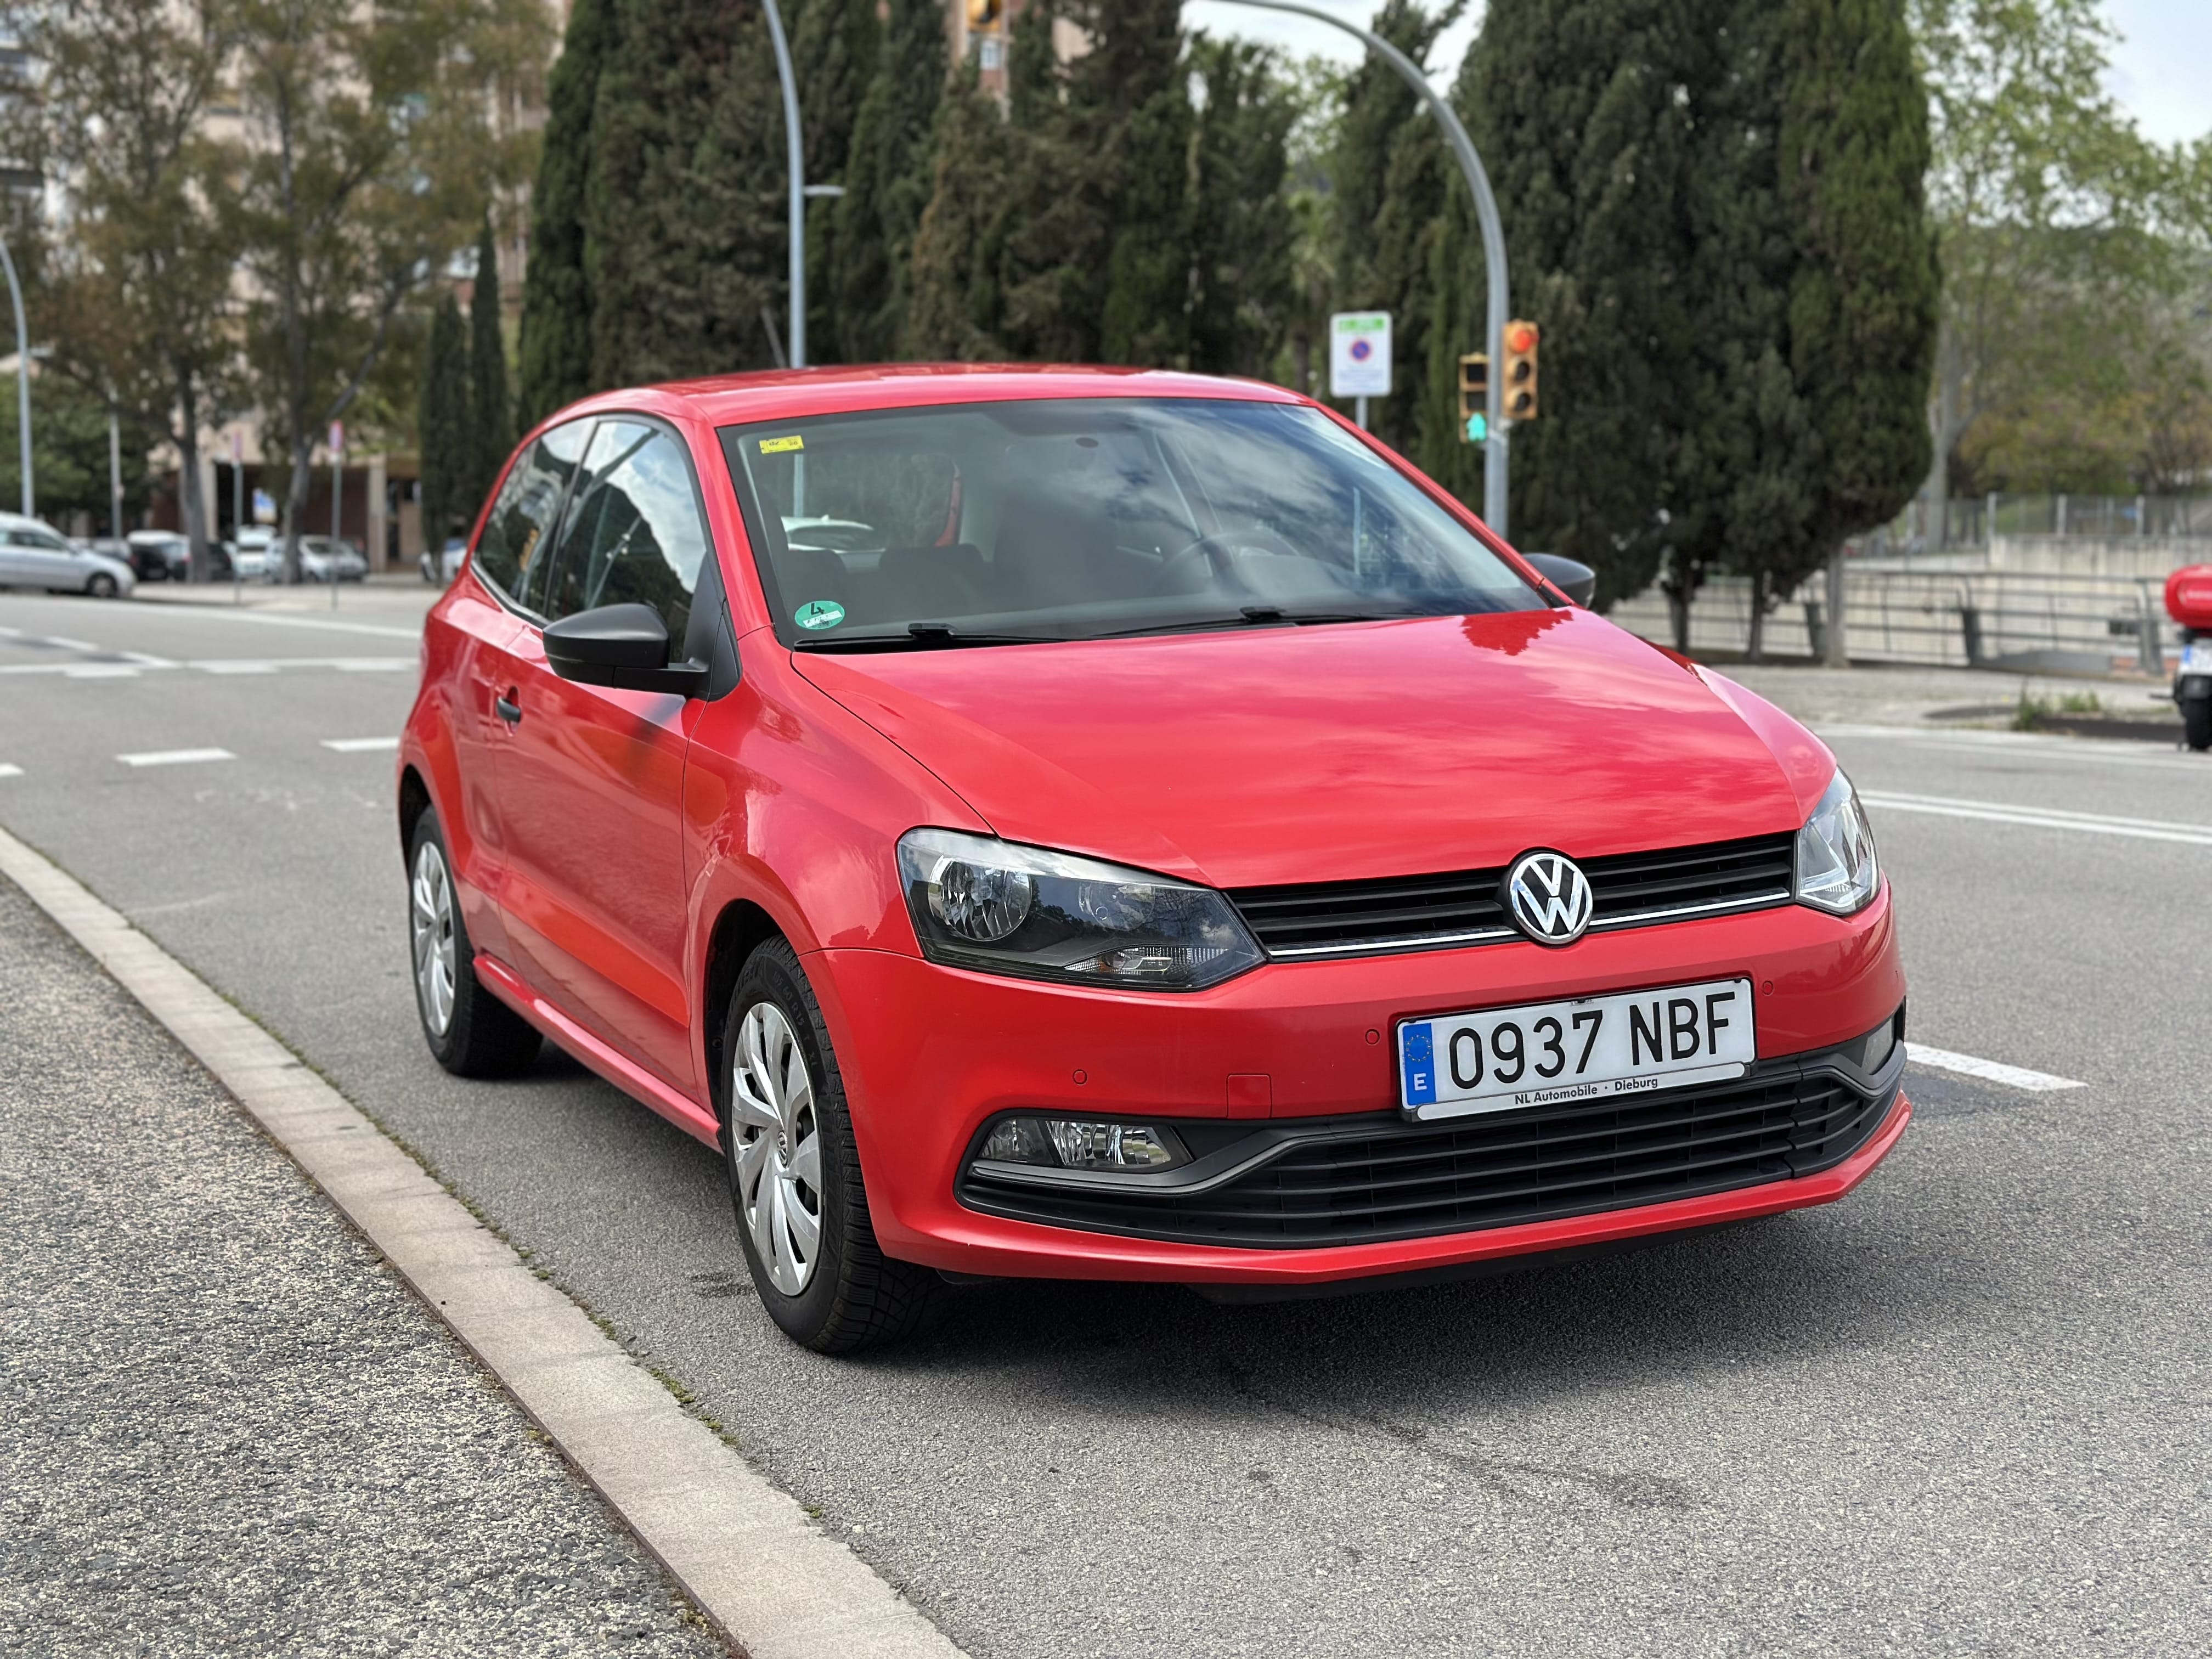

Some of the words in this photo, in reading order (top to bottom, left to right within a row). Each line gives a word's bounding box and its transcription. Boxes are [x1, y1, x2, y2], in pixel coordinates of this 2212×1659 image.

[810, 602, 825, 615] 4
[1510, 853, 1593, 944] VW
[1449, 1009, 1603, 1090] 0937
[1629, 991, 1735, 1066] NBF
[1414, 1073, 1427, 1091] E
[1515, 1094, 1531, 1104] NL
[1534, 1084, 1598, 1103] Automobile
[1615, 1078, 1658, 1091] Dieburg
